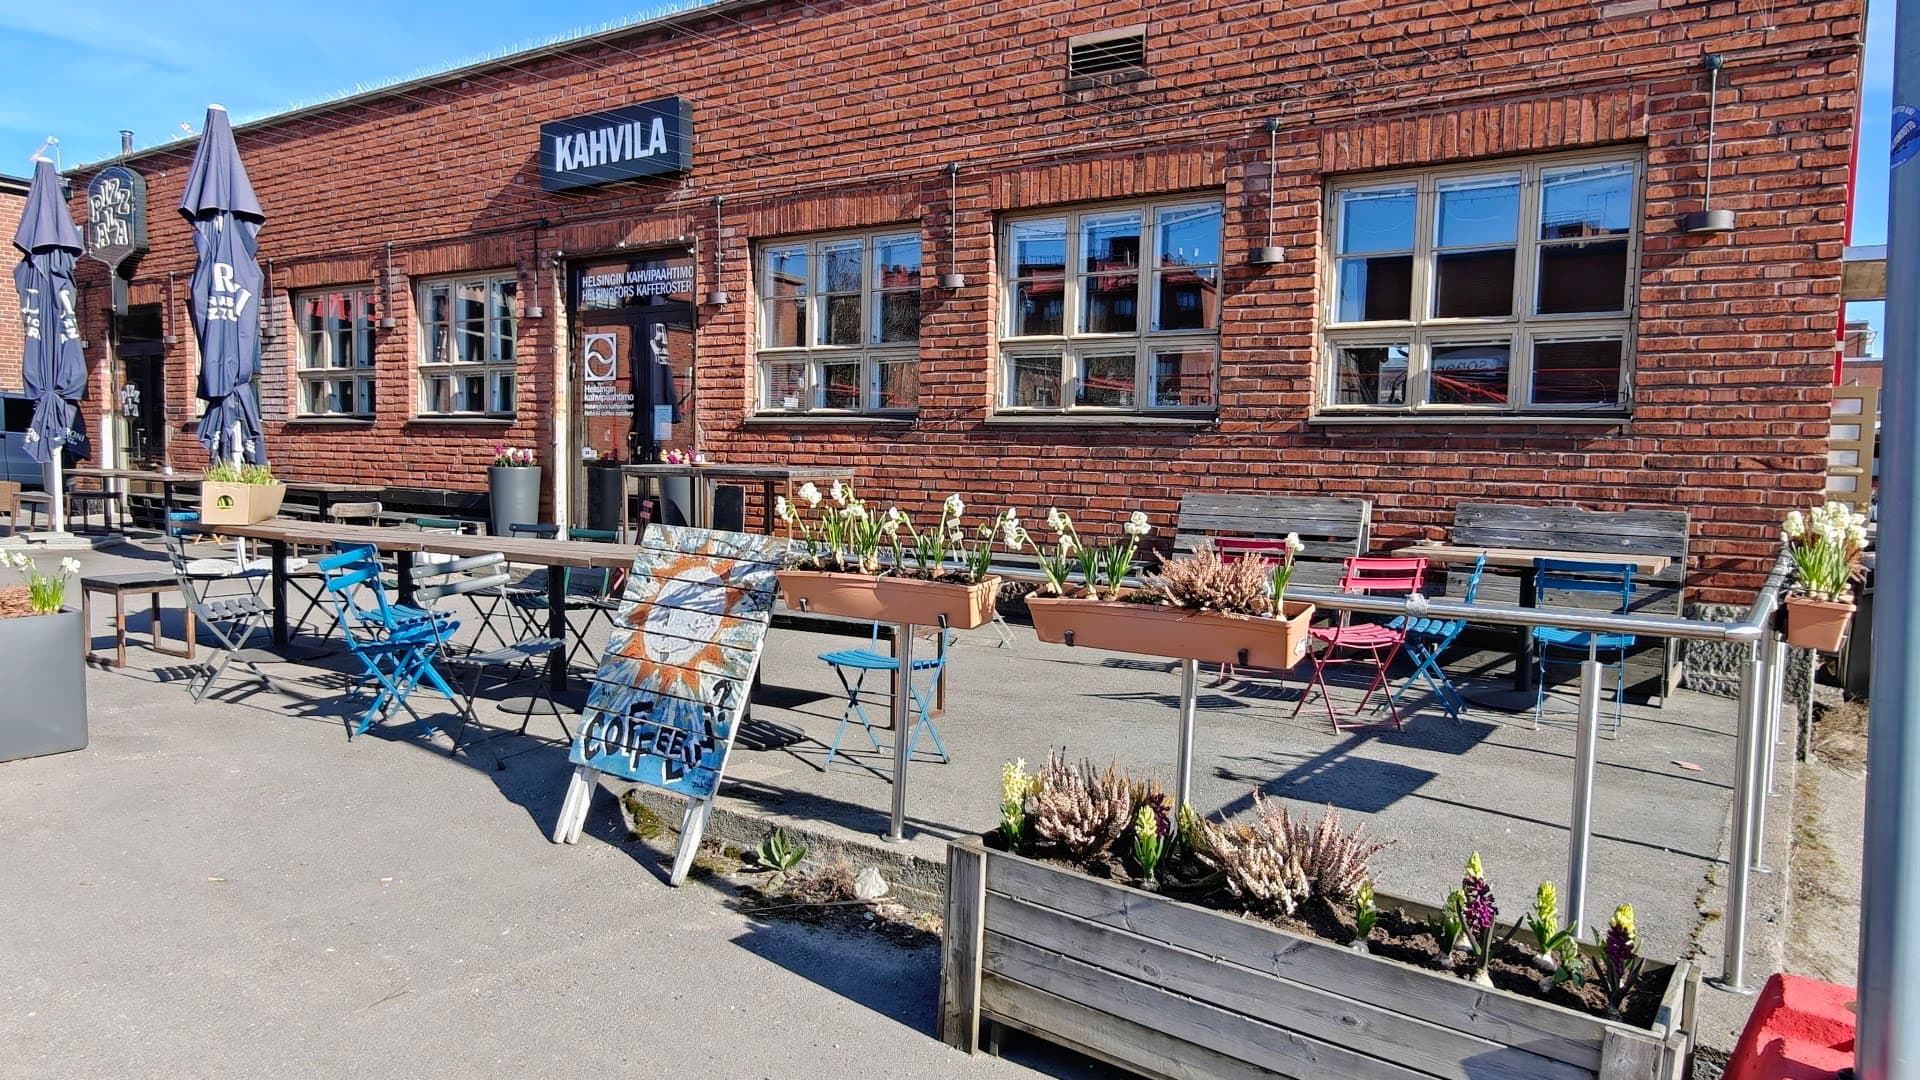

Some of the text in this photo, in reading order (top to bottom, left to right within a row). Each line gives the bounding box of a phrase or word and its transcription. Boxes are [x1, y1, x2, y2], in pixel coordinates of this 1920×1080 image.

[556, 117, 668, 172] KAHVILA
[582, 266, 694, 288] HELSINGIN KAHVIPAAHTIMO
[582, 280, 694, 301] HELSINGFORS KAFFEROSTERI
[584, 384, 616, 394] Helsingin
[584, 392, 634, 402] kahvipaahtimo
[584, 701, 688, 769] COFFEE
